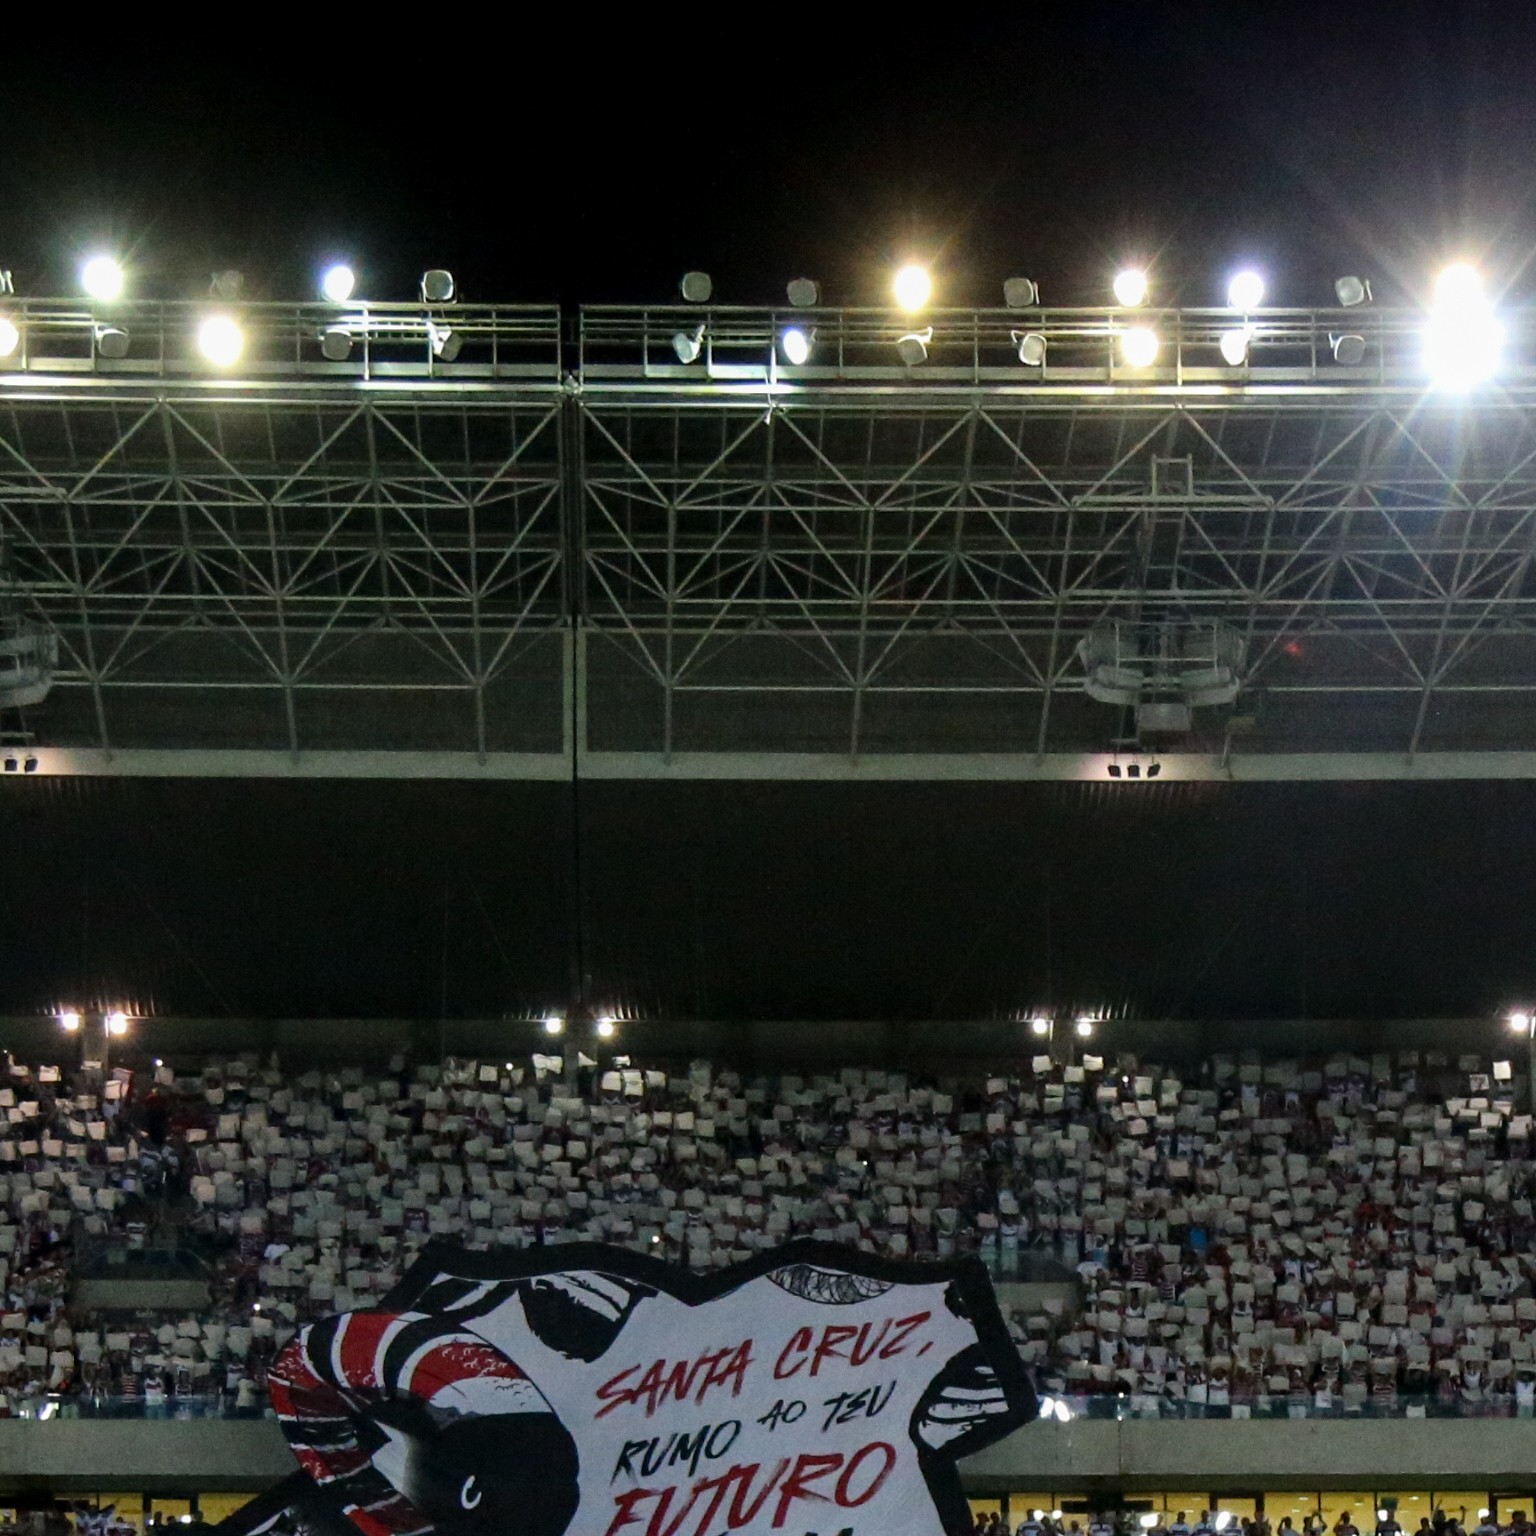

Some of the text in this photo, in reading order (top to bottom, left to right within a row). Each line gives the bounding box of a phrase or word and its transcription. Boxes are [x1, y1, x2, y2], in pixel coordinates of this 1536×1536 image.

[594, 1311, 934, 1419] SANTA CRUZ,
[610, 1381, 896, 1485] RUMO AO TEU
